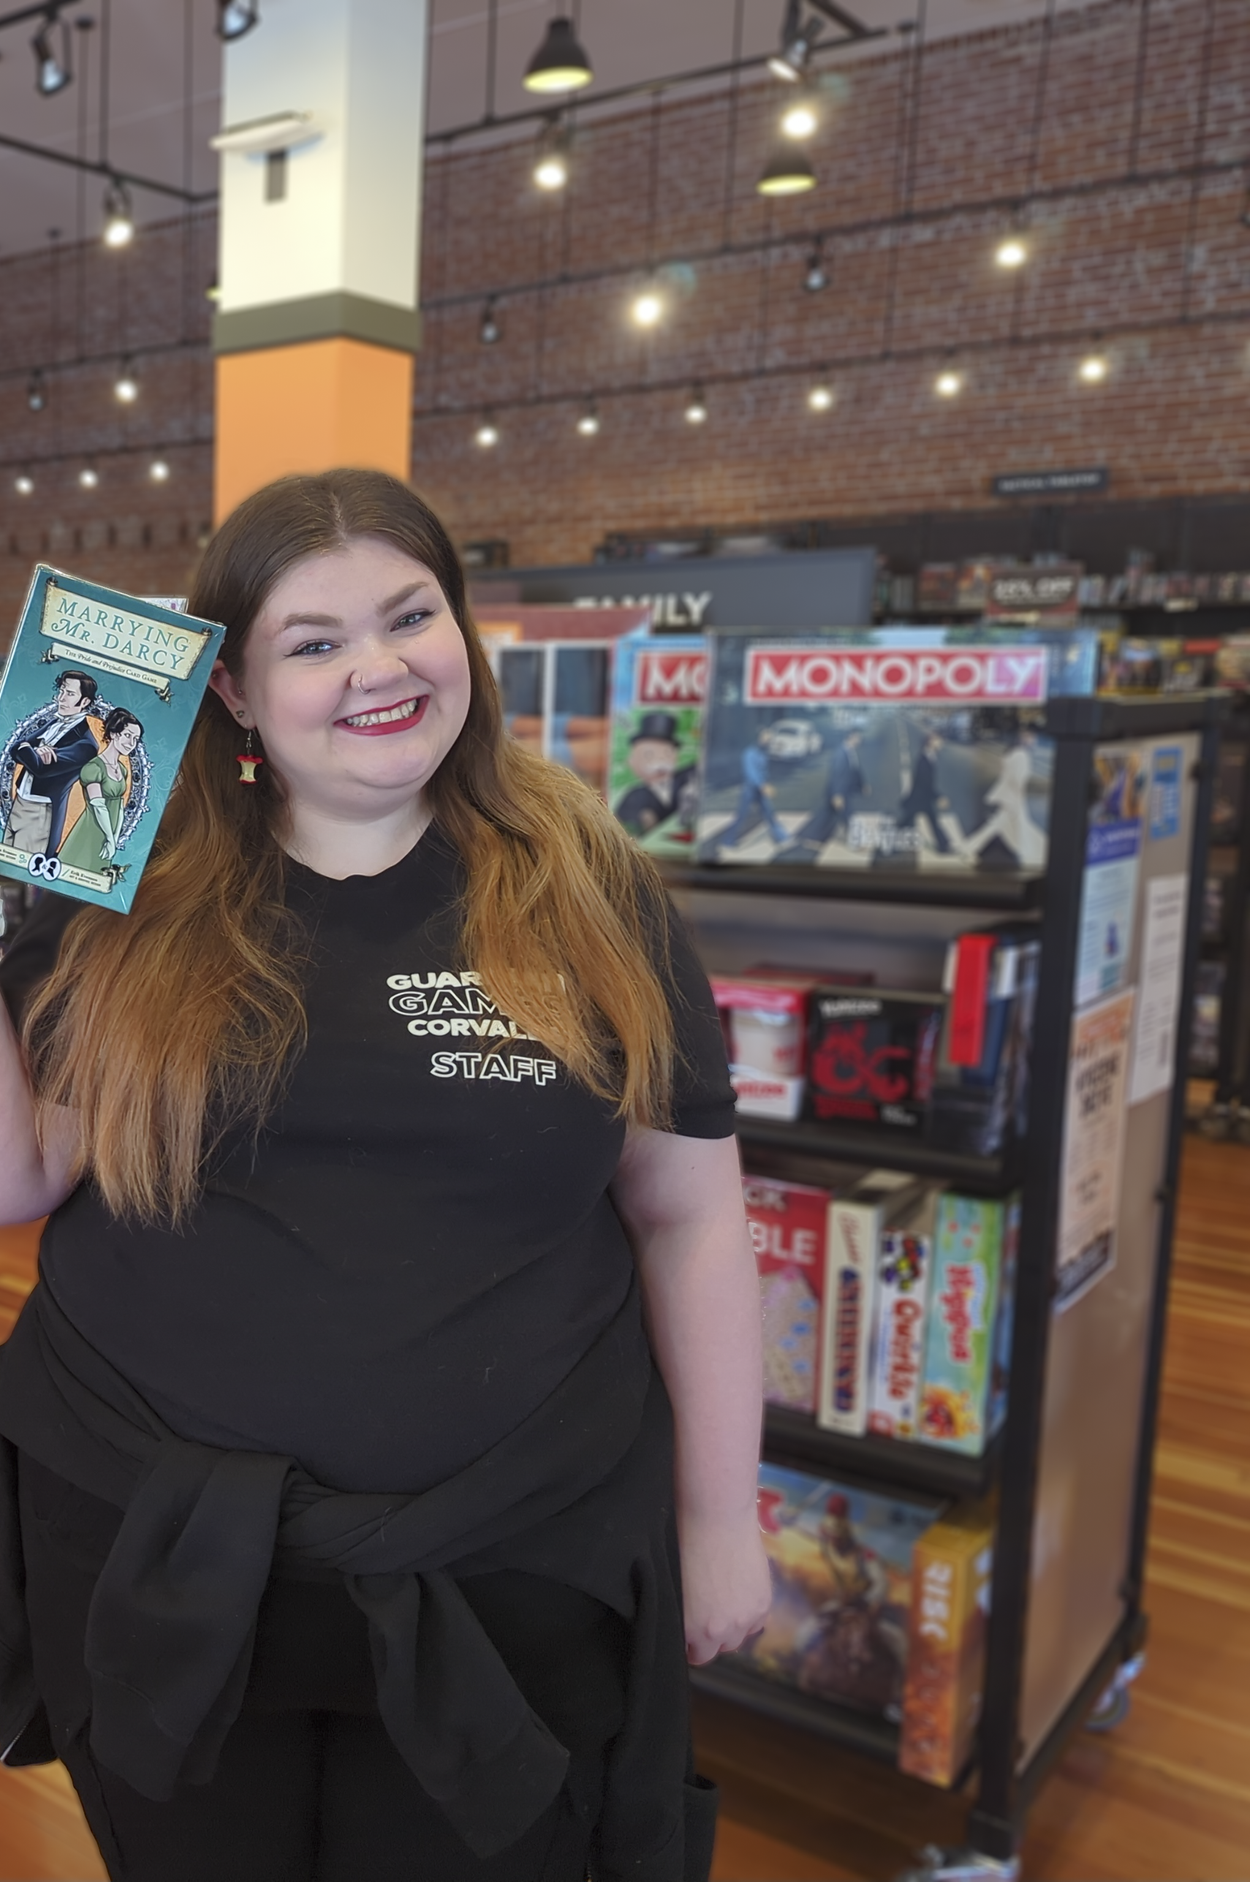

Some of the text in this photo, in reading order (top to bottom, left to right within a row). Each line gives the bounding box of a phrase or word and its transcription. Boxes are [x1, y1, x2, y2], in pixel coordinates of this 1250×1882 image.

[56, 598, 190, 652] MARRYING
[102, 632, 185, 670] DARCY
[756, 656, 1041, 695] MONOPOLY
[386, 971, 484, 990] GUAR
[388, 988, 507, 1016] GAM
[407, 1018, 541, 1041] CORVAL
[430, 1051, 557, 1086] STAFF
